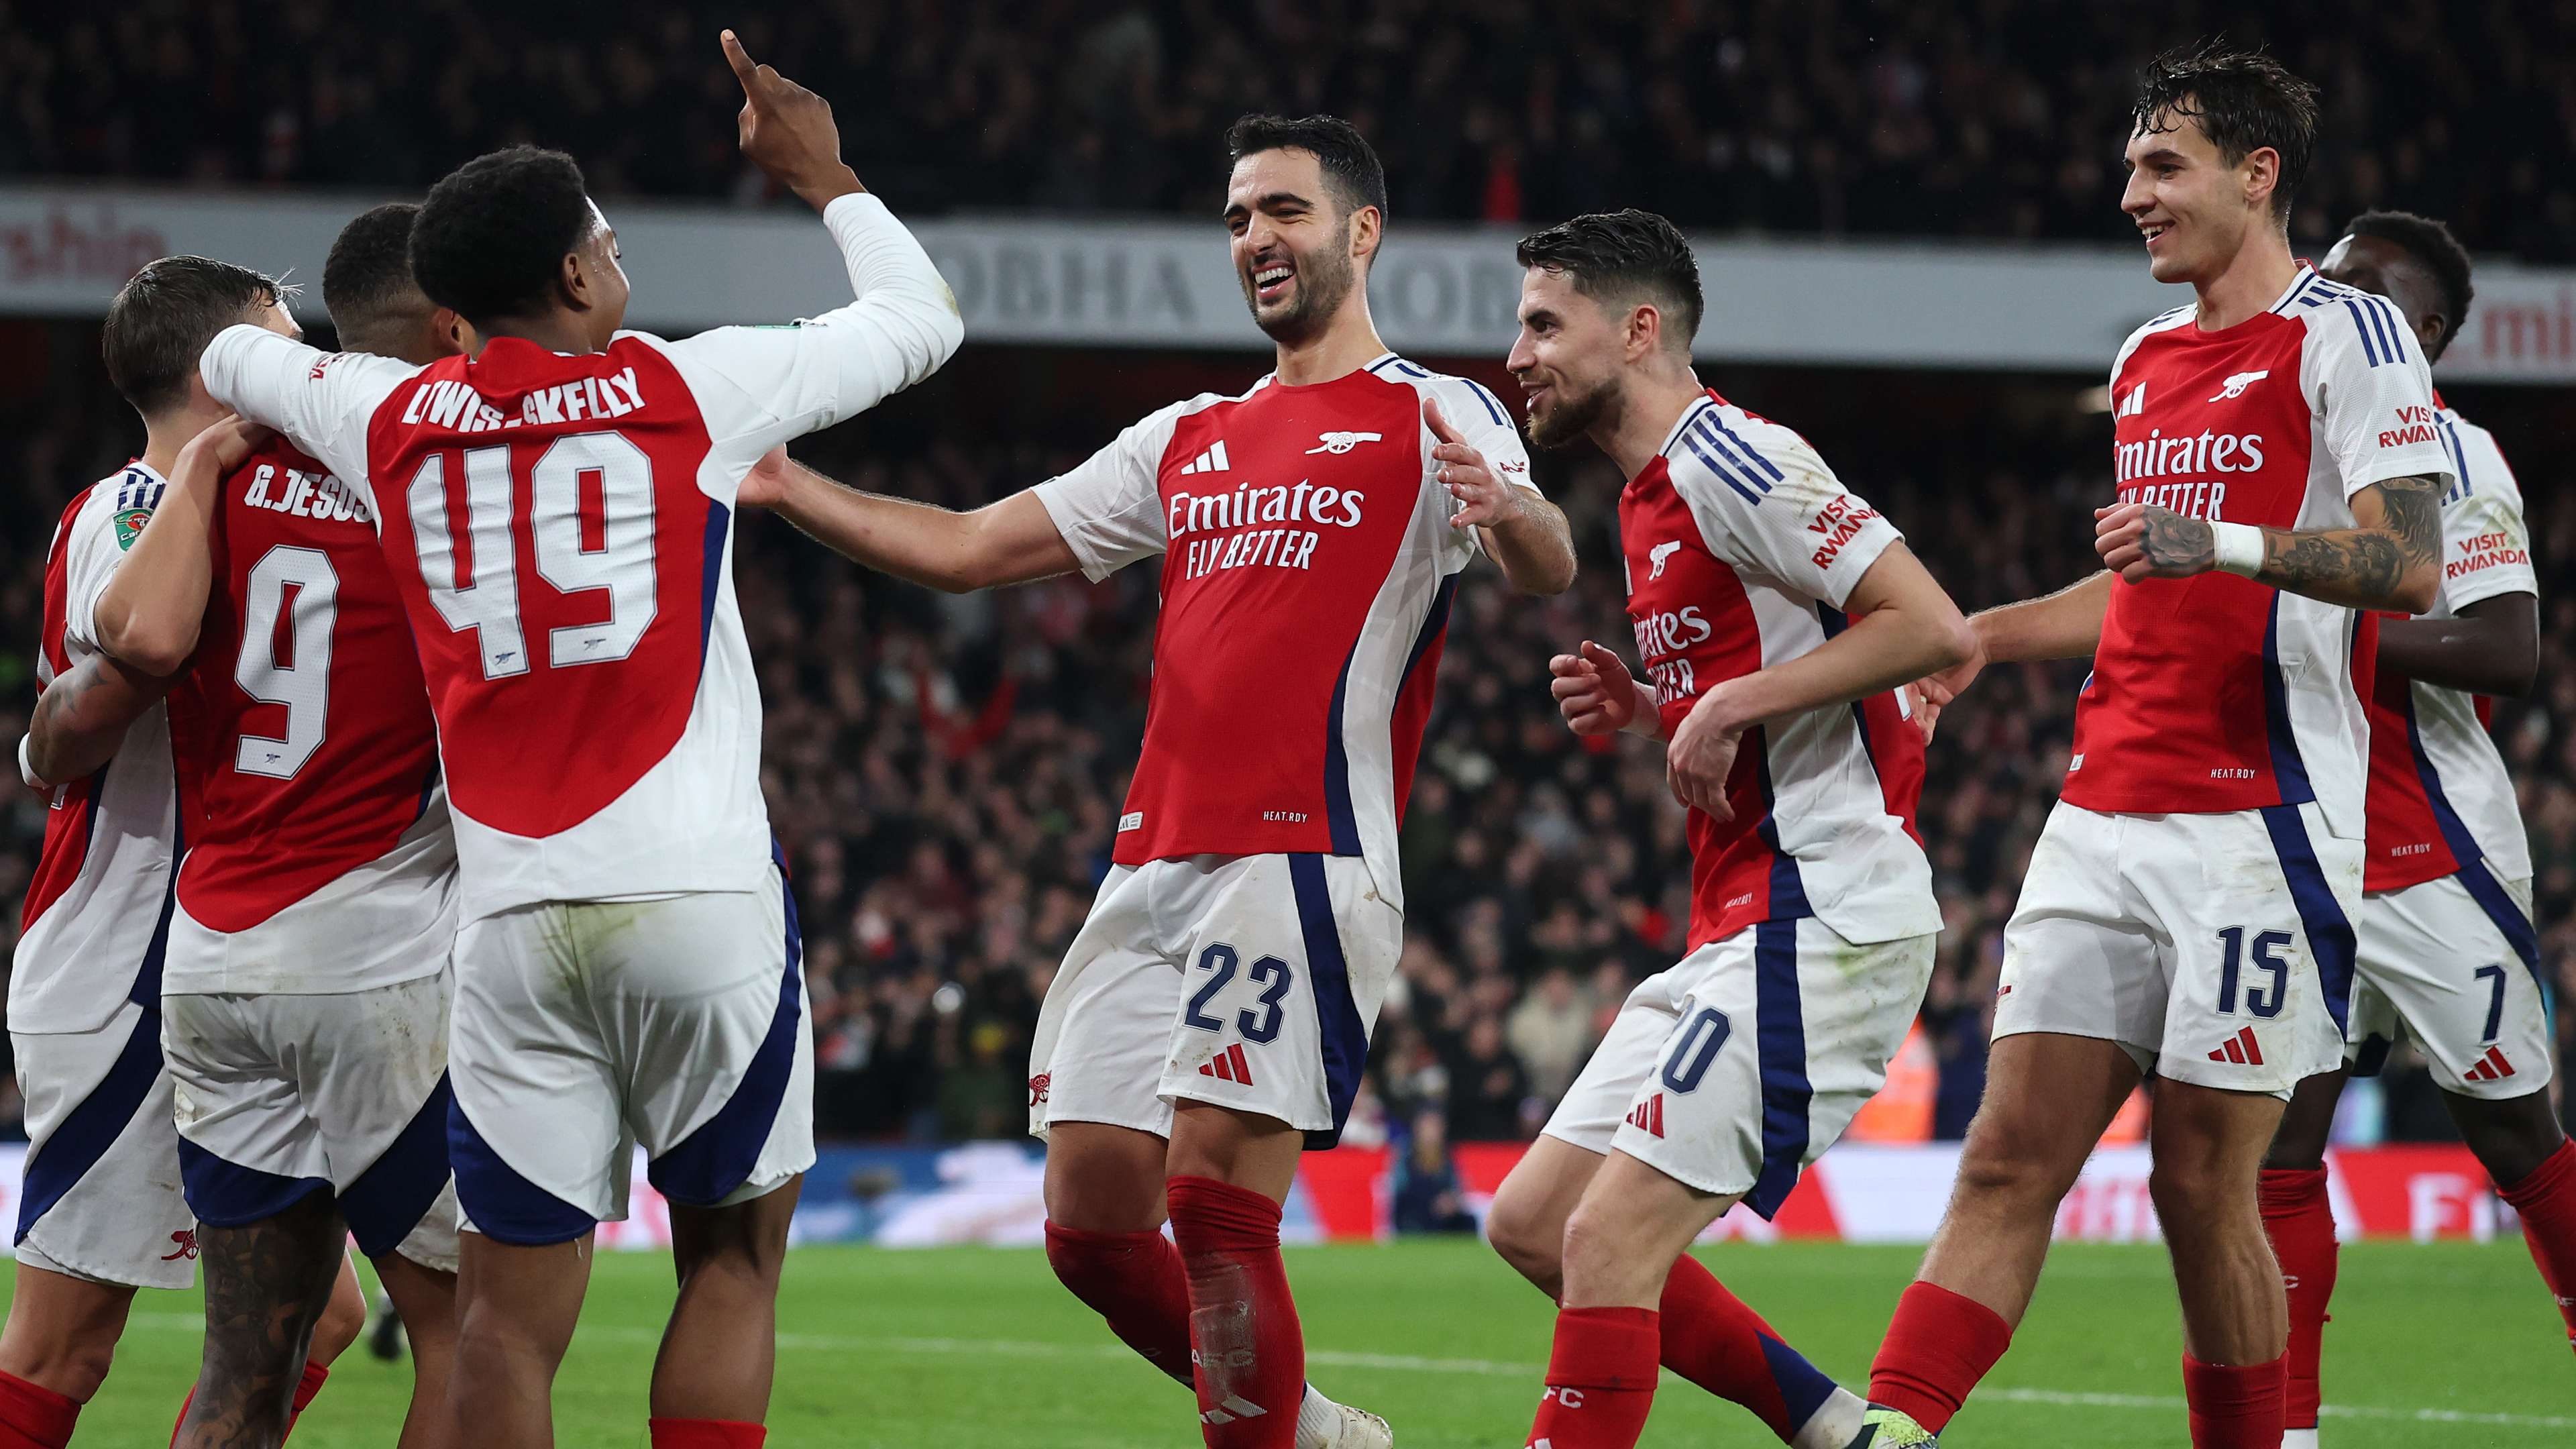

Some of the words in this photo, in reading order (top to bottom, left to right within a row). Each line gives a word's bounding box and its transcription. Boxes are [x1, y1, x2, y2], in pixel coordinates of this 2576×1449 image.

[939, 245, 1199, 321] OBHA
[2378, 425, 2436, 448] RWA
[2396, 406, 2431, 424] VIS
[1169, 478, 1364, 540] Emirates
[406, 429, 658, 681] 49
[1186, 537, 1224, 580] FLY
[1220, 529, 1318, 570] BETTER
[2446, 549, 2528, 580] RWANDA
[2458, 532, 2506, 554] VISIT
[235, 544, 339, 780] 9
[2210, 768, 2255, 780] HEAT.RDY
[1263, 810, 1307, 823] HEAT.RDY
[1181, 941, 1293, 1046] 23
[2216, 925, 2295, 1020] 15
[2473, 964, 2506, 1044] 7
[1649, 998, 1733, 1096] 0
[1543, 1386, 1584, 1408] FC
